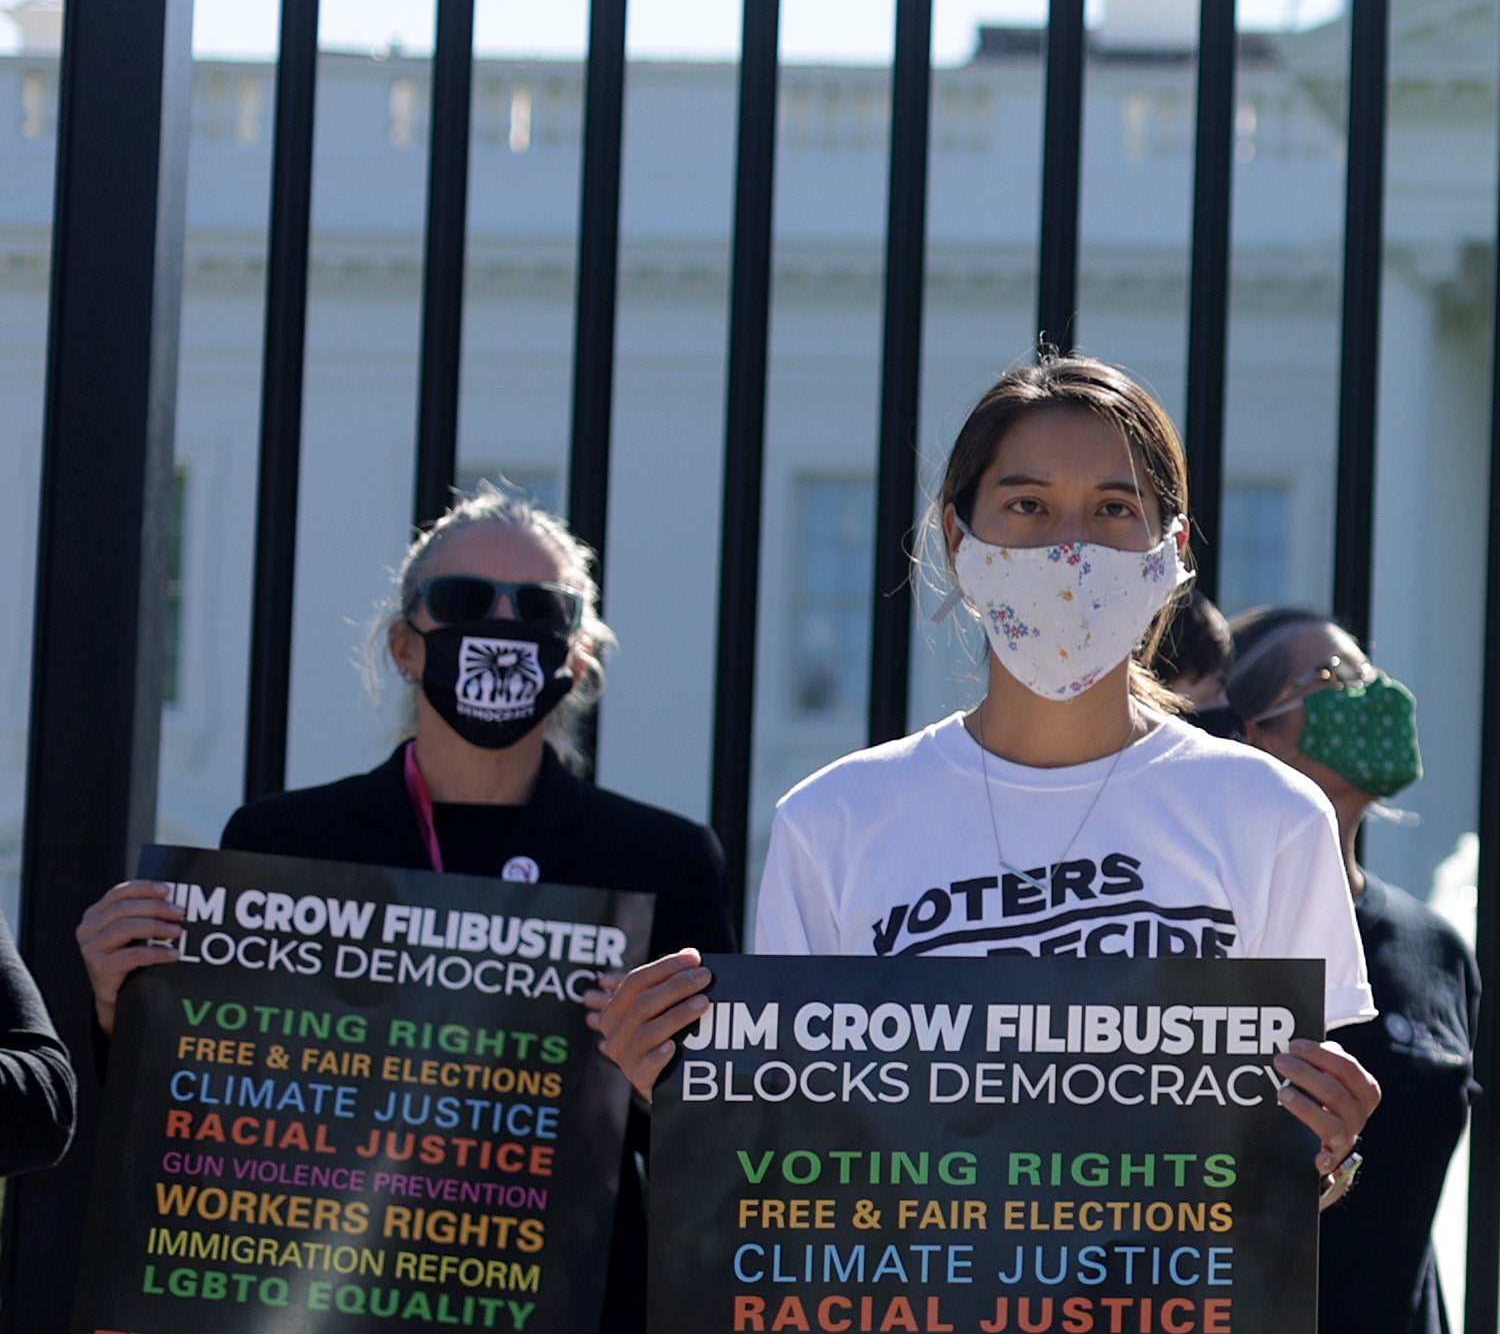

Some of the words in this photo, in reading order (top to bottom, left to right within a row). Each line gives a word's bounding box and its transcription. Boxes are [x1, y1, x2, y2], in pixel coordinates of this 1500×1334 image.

[235, 889, 376, 940] CROW
[382, 903, 627, 967] FILIBUSTER
[872, 853, 1144, 956] VOTERS
[335, 944, 602, 1003] DEMOCRAC
[181, 998, 368, 1043] VOTING
[389, 1020, 569, 1065] RIGHTS
[683, 1003, 778, 1051] JIM
[794, 1003, 974, 1053] CROW
[986, 1005, 1295, 1055] FILIBUSTER
[178, 1036, 255, 1067] FREE
[267, 1044, 289, 1070] &
[302, 1048, 371, 1078] FAIR
[382, 1056, 562, 1097] ELECTIONS
[682, 1061, 911, 1105] BLOCKS
[170, 1070, 358, 1119] CLIMATE
[373, 1090, 558, 1140] JUSTICE
[166, 1109, 336, 1155] RACIAL
[356, 1129, 554, 1176] JUSTICE
[736, 1150, 978, 1186] VOTING
[1008, 1152, 1238, 1187] RIGHTS
[162, 1151, 222, 1178] GUN
[232, 1158, 365, 1193] VIOLENCE
[373, 1171, 548, 1211] PREVENTION
[154, 1183, 370, 1235] WORKERS
[382, 1206, 545, 1253] RIGHTS
[738, 1199, 835, 1229] FREE
[852, 1199, 881, 1229] &
[898, 1201, 987, 1230] FAIR
[1004, 1201, 1234, 1232] ELECTIONS
[147, 1227, 384, 1278] IMMIGRATION
[396, 1253, 539, 1293] REFORM
[734, 1243, 975, 1285] CLIMATE
[998, 1245, 1233, 1286] JUSTICE
[142, 1266, 291, 1308] LGBTQ
[308, 1283, 536, 1331] EQUALITY
[734, 1296, 953, 1333] RACIAL
[979, 1298, 1231, 1334] JUSTICE
